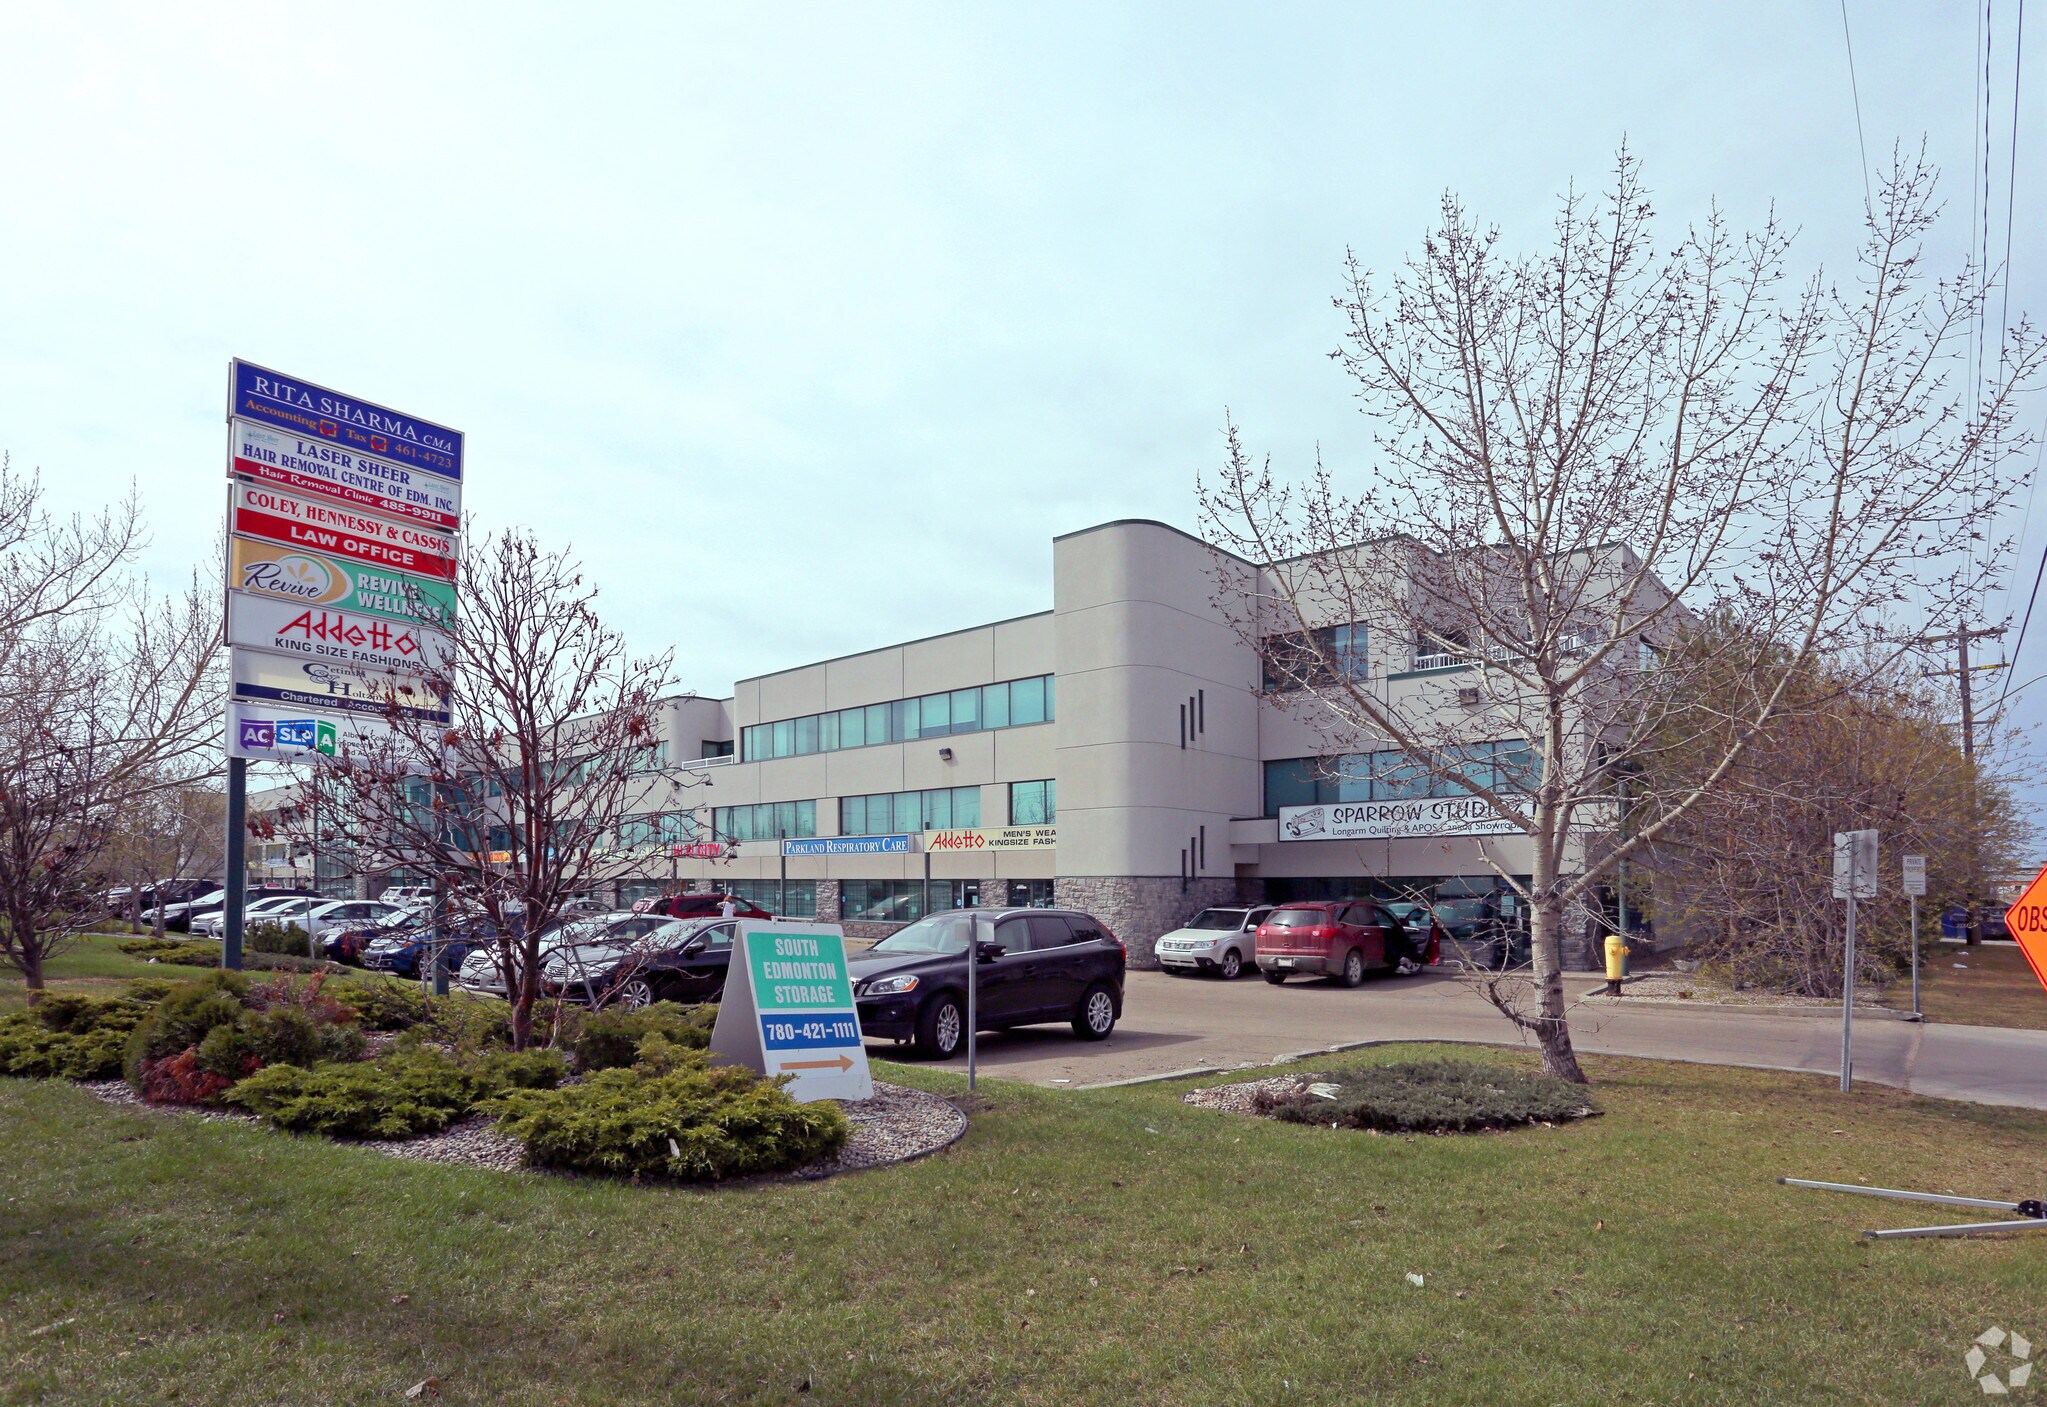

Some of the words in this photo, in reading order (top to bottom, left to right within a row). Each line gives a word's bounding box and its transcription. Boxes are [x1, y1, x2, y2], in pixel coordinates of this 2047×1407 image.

[254, 375, 313, 409] RITA
[320, 397, 418, 441] SHARMA
[423, 435, 452, 451] CMA
[245, 399, 317, 430] Accounting
[346, 428, 367, 443] Tax
[395, 443, 452, 469] 461-4723
[296, 441, 352, 469] LASER
[357, 459, 410, 485] SHEER
[243, 443, 277, 464] HAIR
[281, 453, 338, 481] REMOVAL
[341, 471, 384, 494] CENTRE
[388, 484, 403, 498] OF
[406, 489, 432, 507] EDM.
[435, 497, 455, 513] INC.
[258, 465, 286, 481] Hair
[290, 474, 341, 495] Removal
[344, 488, 374, 504] Clinic
[379, 499, 442, 522] 485-9911
[246, 491, 301, 518] COLEY,
[306, 505, 383, 536] HENNESSY
[386, 526, 399, 540] &
[402, 530, 450, 553] CASSIS
[290, 526, 338, 547] LAW
[343, 539, 414, 566] OFFICE
[244, 562, 322, 599] Revive
[358, 572, 419, 600] REVIVE
[277, 609, 417, 656] Addetto
[275, 637, 312, 652] KING
[315, 644, 348, 659] SIZE
[352, 650, 420, 670] FASHIONS
[280, 691, 338, 707] Chartered
[1332, 803, 1423, 824] SPARROW
[929, 830, 985, 850] Addetto
[1003, 830, 1031, 838] MEN'S
[1035, 829, 1056, 837] WEA
[988, 838, 1028, 846] KINGSIZE
[1332, 826, 1366, 837] Longarm
[1369, 825, 1401, 836] Quilting
[1475, 820, 1523, 831] Showroo
[785, 841, 825, 854] PARKLAND
[826, 839, 881, 853] RESPIRATORY
[882, 838, 908, 851] CARE
[2017, 905, 2047, 933] OBS
[774, 938, 819, 957] SOUTH
[763, 961, 837, 980] EDMONTON
[774, 985, 836, 1004] STORAGE
[766, 1022, 855, 1041] 780-421-1111
